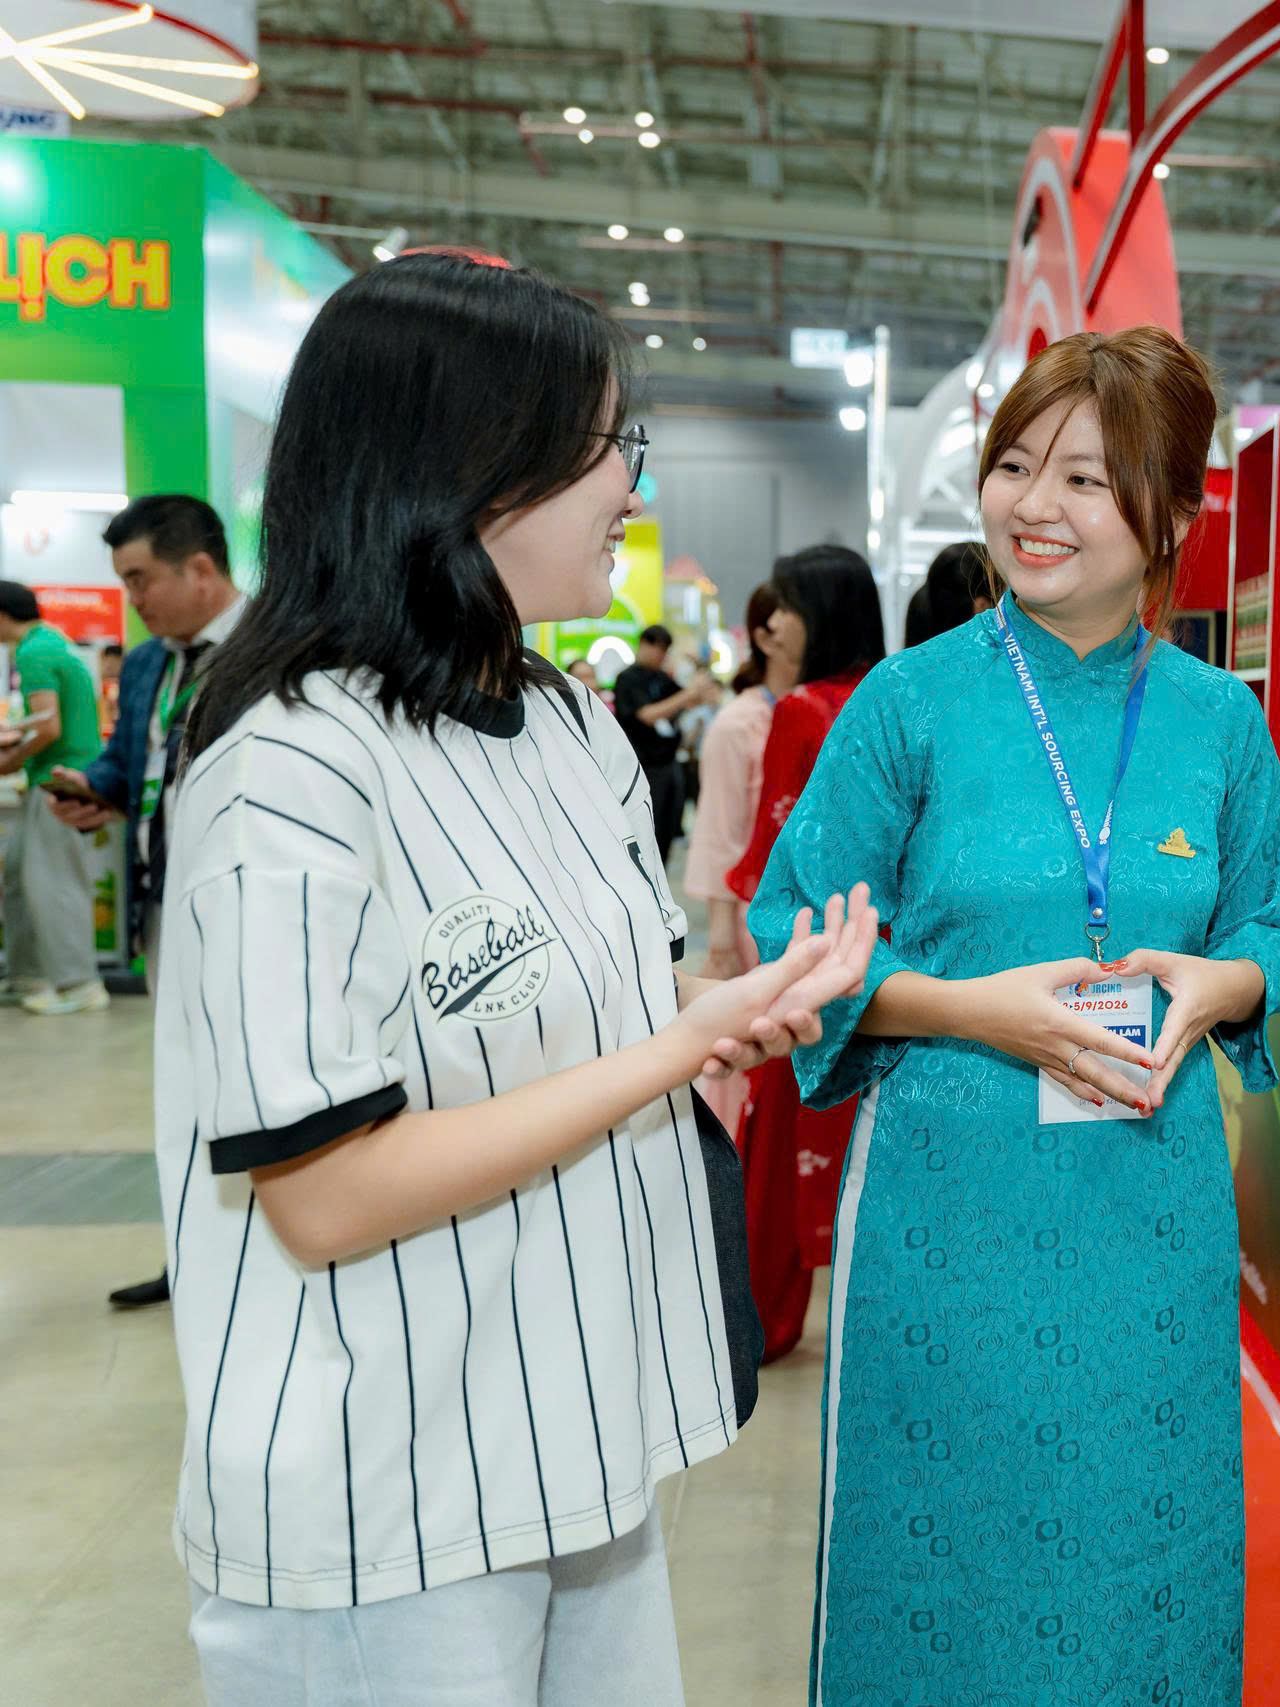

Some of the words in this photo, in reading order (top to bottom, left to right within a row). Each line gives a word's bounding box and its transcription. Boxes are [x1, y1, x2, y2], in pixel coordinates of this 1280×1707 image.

[1003, 633, 1035, 693] VIETNAM
[1027, 695, 1048, 730] INT'L
[1042, 732, 1076, 806] SOURCING
[1070, 809, 1091, 848] EXPO
[438, 904, 491, 938] QUALITY
[421, 905, 544, 1009] Baseball
[511, 970, 541, 1005] CLUB
